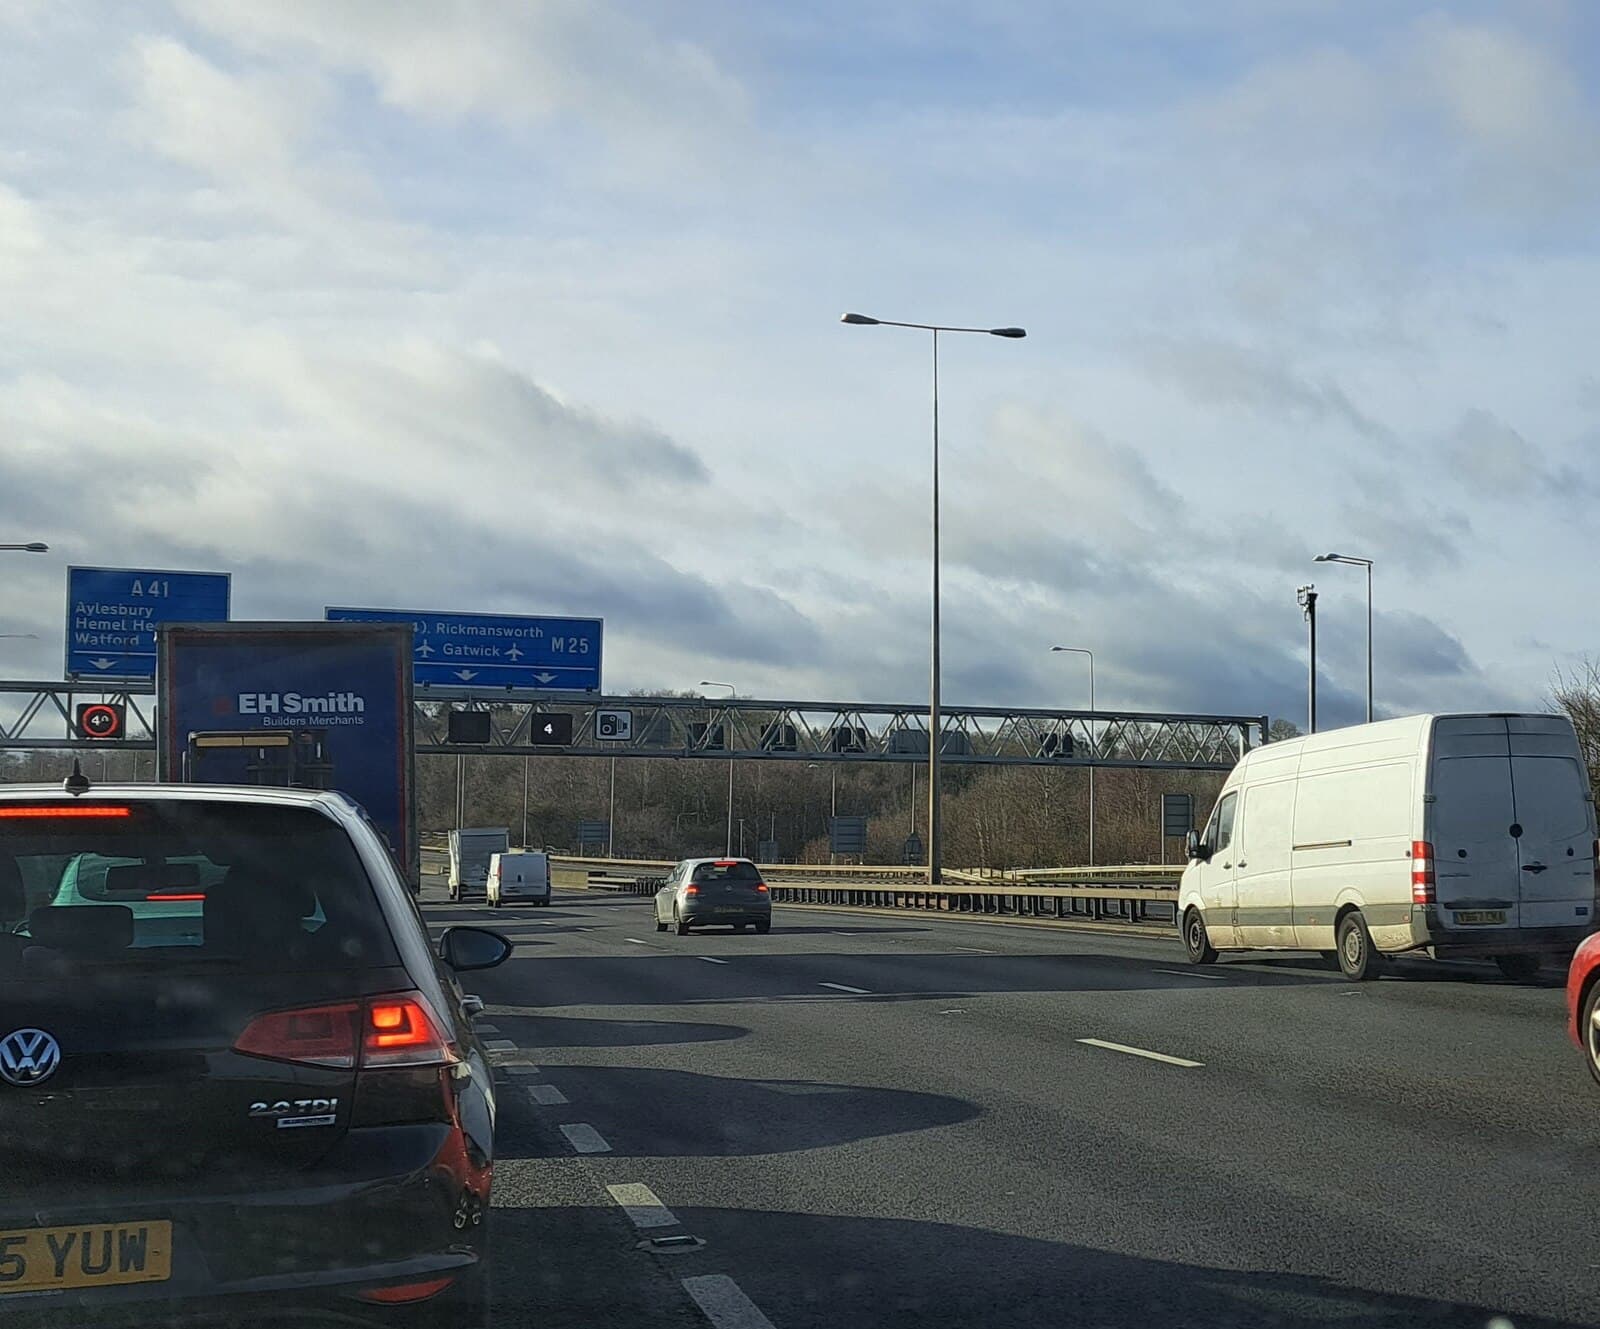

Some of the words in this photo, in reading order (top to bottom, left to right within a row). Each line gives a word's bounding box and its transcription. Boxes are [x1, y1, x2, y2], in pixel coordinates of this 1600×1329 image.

[75, 601, 154, 618] Aylesbury
[75, 617, 127, 632] Hemel
[436, 622, 544, 639] Rickmansworth
[75, 632, 140, 646] Watford
[443, 643, 500, 657] Gatwick
[263, 716, 306, 727] Builders
[309, 715, 365, 726] Merchants
[543, 723, 553, 735] 4
[294, 1098, 338, 1114] TDI
[47, 1228, 148, 1277] YUW
